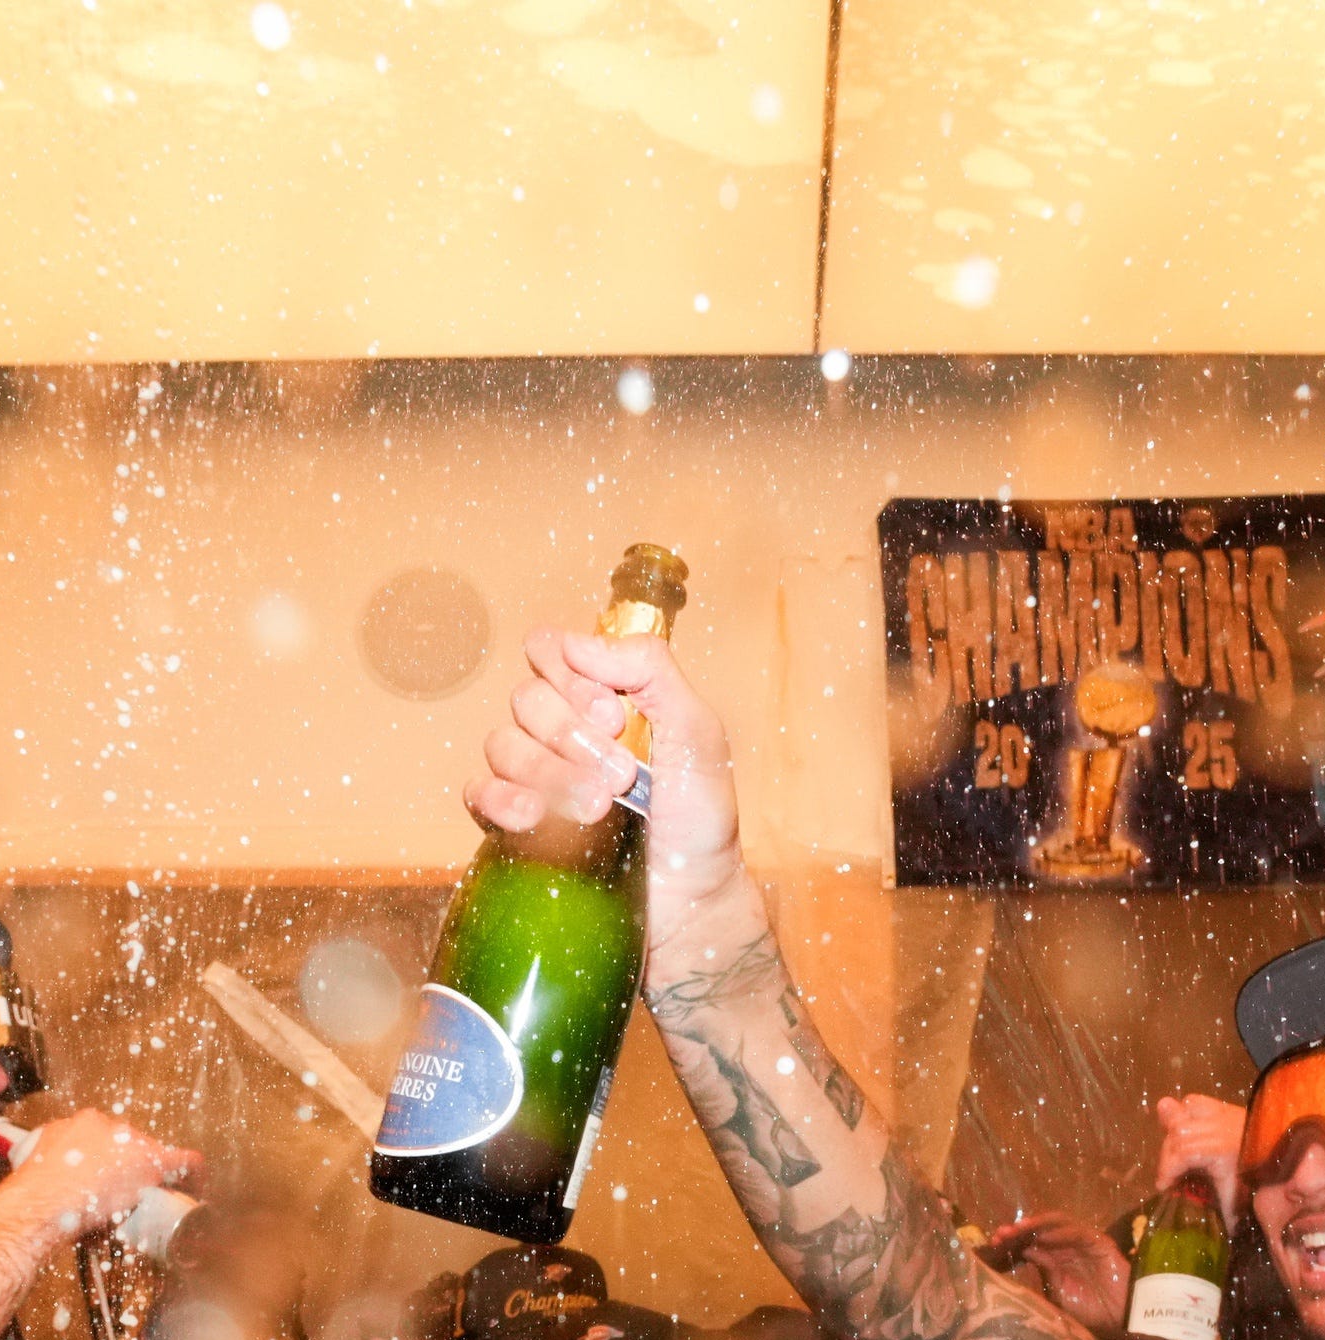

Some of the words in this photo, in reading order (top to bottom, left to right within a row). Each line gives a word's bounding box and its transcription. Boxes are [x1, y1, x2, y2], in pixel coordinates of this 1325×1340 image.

[905, 545, 1293, 724] CHAMPIONS
[975, 720, 1031, 789] 20
[1183, 719, 1239, 790] 25
